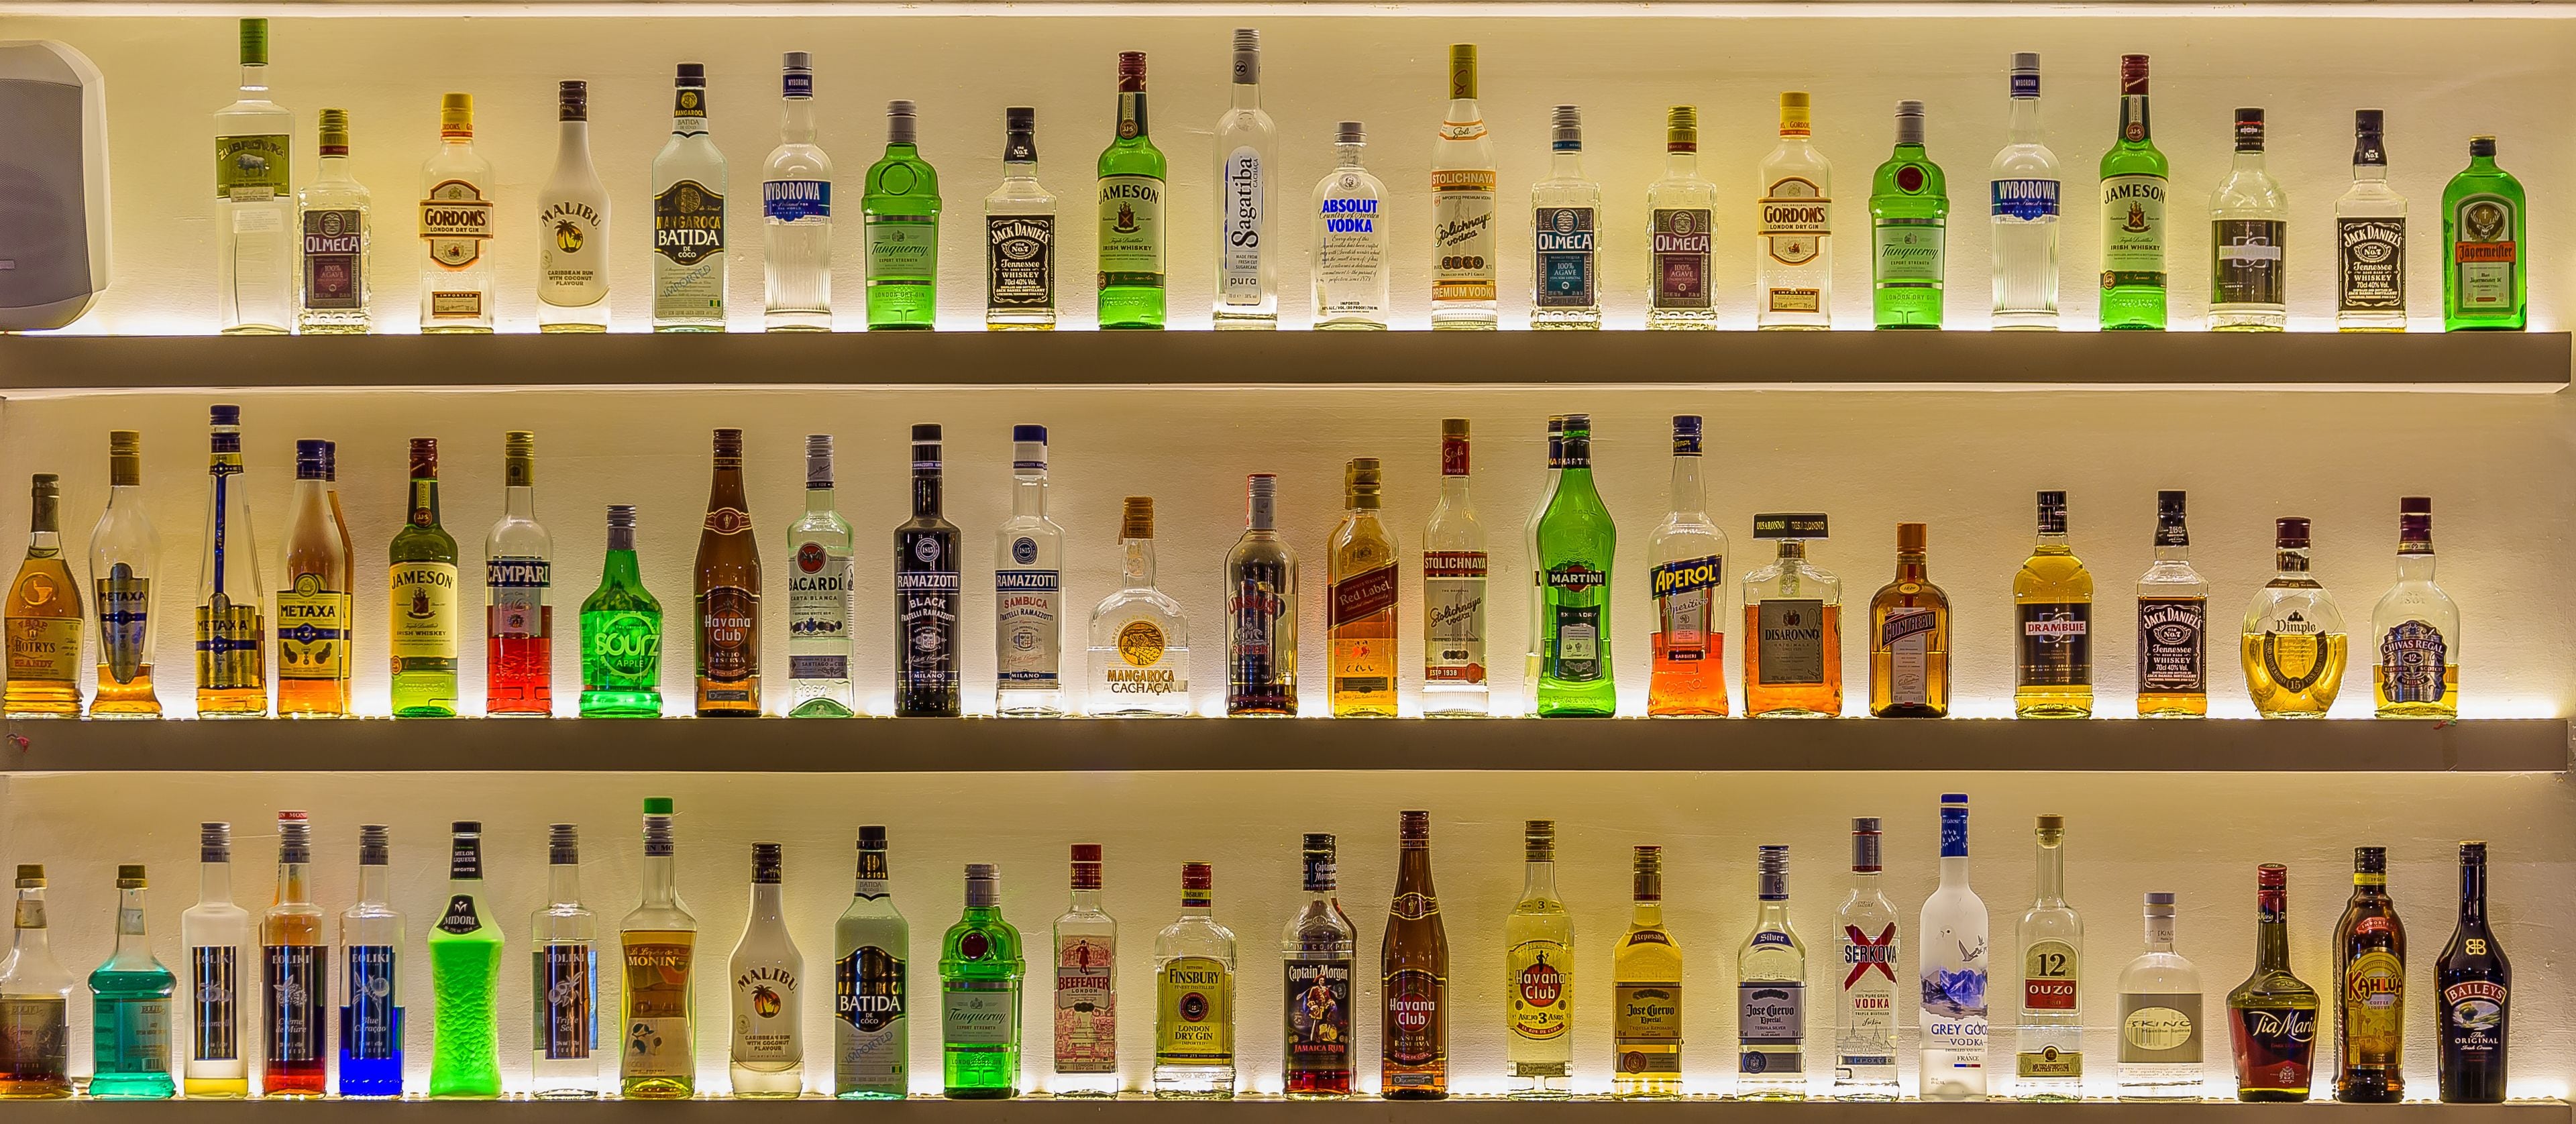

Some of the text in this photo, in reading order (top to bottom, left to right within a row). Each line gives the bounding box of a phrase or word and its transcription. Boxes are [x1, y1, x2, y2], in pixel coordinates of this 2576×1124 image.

[1432, 176, 1494, 185] STOLICHNAYA
[765, 181, 820, 201] WYBOROWA
[1097, 184, 1160, 205] JAMESON
[1998, 180, 2055, 201] WYBOROWA
[2104, 184, 2166, 205] JAMESON
[1231, 158, 1260, 249] Sagatiba
[1322, 199, 1379, 215] ABSOLUT
[424, 208, 486, 227] GORDON'S
[541, 201, 603, 231] MALIBU
[1763, 205, 1826, 223] GORDON'S
[655, 216, 721, 231] MANGAROCA
[1327, 219, 1373, 233] VODKA
[1435, 209, 1493, 247] Stolichnaya
[657, 229, 720, 246] BATIDA
[991, 222, 1051, 245] JACK DANIEL'S
[2343, 225, 2402, 248] JACK DANIEL'S
[305, 235, 360, 253] OLMECA
[871, 241, 929, 257] Tanqueray
[1538, 235, 1593, 251] OLMECA
[1655, 235, 1710, 251] OLMECA
[1882, 243, 1939, 260] Tanqueray
[2458, 244, 2513, 260] Jägermeister
[1000, 259, 1040, 269] Tennessee
[2353, 262, 2393, 272] Tennessee
[662, 264, 712, 299] IMPORTED
[1001, 271, 1040, 279] WHISKEY
[1230, 276, 1258, 288] pura
[1433, 286, 1495, 300] PREMIUM VODKA
[1756, 520, 1786, 531] DISARONNO
[1790, 519, 1825, 531] DISARONNO
[1424, 557, 1487, 570] STOLICHNAYA
[391, 569, 453, 591] JAMESON
[486, 565, 551, 583] CAMPARI
[788, 571, 843, 592] BACARDÍ
[897, 574, 959, 589] RAMAZZOTTI
[1550, 571, 1603, 585] MARTINI
[1654, 564, 1716, 594] APEROL
[997, 574, 1057, 590] RAMAZZOTTI
[99, 591, 146, 602] METAXA
[1338, 580, 1393, 608] Red Label.
[910, 597, 947, 610] BLACK
[1004, 596, 1049, 610] SAMBUCA
[1228, 593, 1279, 616] URSUS
[279, 604, 336, 618] METAXA
[901, 608, 956, 622] FRATELLI RAMAZZOTTI
[999, 607, 1054, 622] FRATELLI RAMAZZOTTI
[1430, 597, 1483, 628] Stolichnaya
[197, 620, 249, 632] METAXA
[705, 614, 750, 633] Havana
[2144, 607, 2203, 632] JACK DANIEL'S
[1765, 628, 1820, 642] DISARONNO
[1883, 612, 1934, 643] COINTREAU
[2027, 622, 2086, 633] DRAMBUIE
[2274, 619, 2317, 636] Dimple
[15, 639, 56, 653] BOTRYS
[713, 631, 742, 647] Club
[2153, 644, 2192, 654] Tennessee
[2383, 640, 2444, 654] CHIVAS REGAL
[616, 659, 644, 669] APPLE
[2153, 657, 2192, 665] WHISKEY
[1010, 672, 1040, 680] MILANO
[1106, 669, 1175, 683] MANGAROCA
[2401, 677, 2426, 687] WHISKY
[1111, 683, 1172, 696] CACHAÇA
[2288, 679, 2302, 690] 15
[859, 881, 882, 889] BATIDA
[443, 915, 476, 927] MIDORI
[1633, 933, 1666, 942] Reposado
[1760, 932, 1784, 942] Silver
[196, 956, 234, 966] EOLIKI
[272, 955, 309, 966] EOLIKI
[351, 955, 389, 966] EOLIKI
[628, 955, 675, 967] MONIN
[1844, 943, 1897, 965] SERKOVA
[2037, 952, 2068, 977] 12
[737, 965, 796, 994] MALIBU
[1169, 968, 1221, 985] FINSBURY
[1287, 966, 1349, 985] Captain Morgan
[1515, 970, 1566, 985] Havana
[1058, 976, 1110, 991] BEEFEATER
[2028, 985, 2074, 997] OUZO
[2348, 970, 2404, 1002] KAHLÚA
[1525, 984, 1556, 1001] Club
[2449, 987, 2506, 1004] BAILEYS
[839, 995, 902, 1013] BATIDA
[1389, 998, 1436, 1012] Havana
[1854, 998, 1890, 1009] VODKA
[362, 1016, 379, 1026] Blue
[949, 1007, 1006, 1024] Tanqueray
[1397, 1011, 1426, 1026] Club
[1177, 1024, 1210, 1033] LONDON
[2248, 1010, 2281, 1038] Tia
[1173, 1031, 1214, 1043] DRY GIN
[1949, 1037, 1984, 1046] VODKA
[844, 1030, 894, 1065] IMPORTED
[1293, 1044, 1345, 1055] JAMAICA RUM
